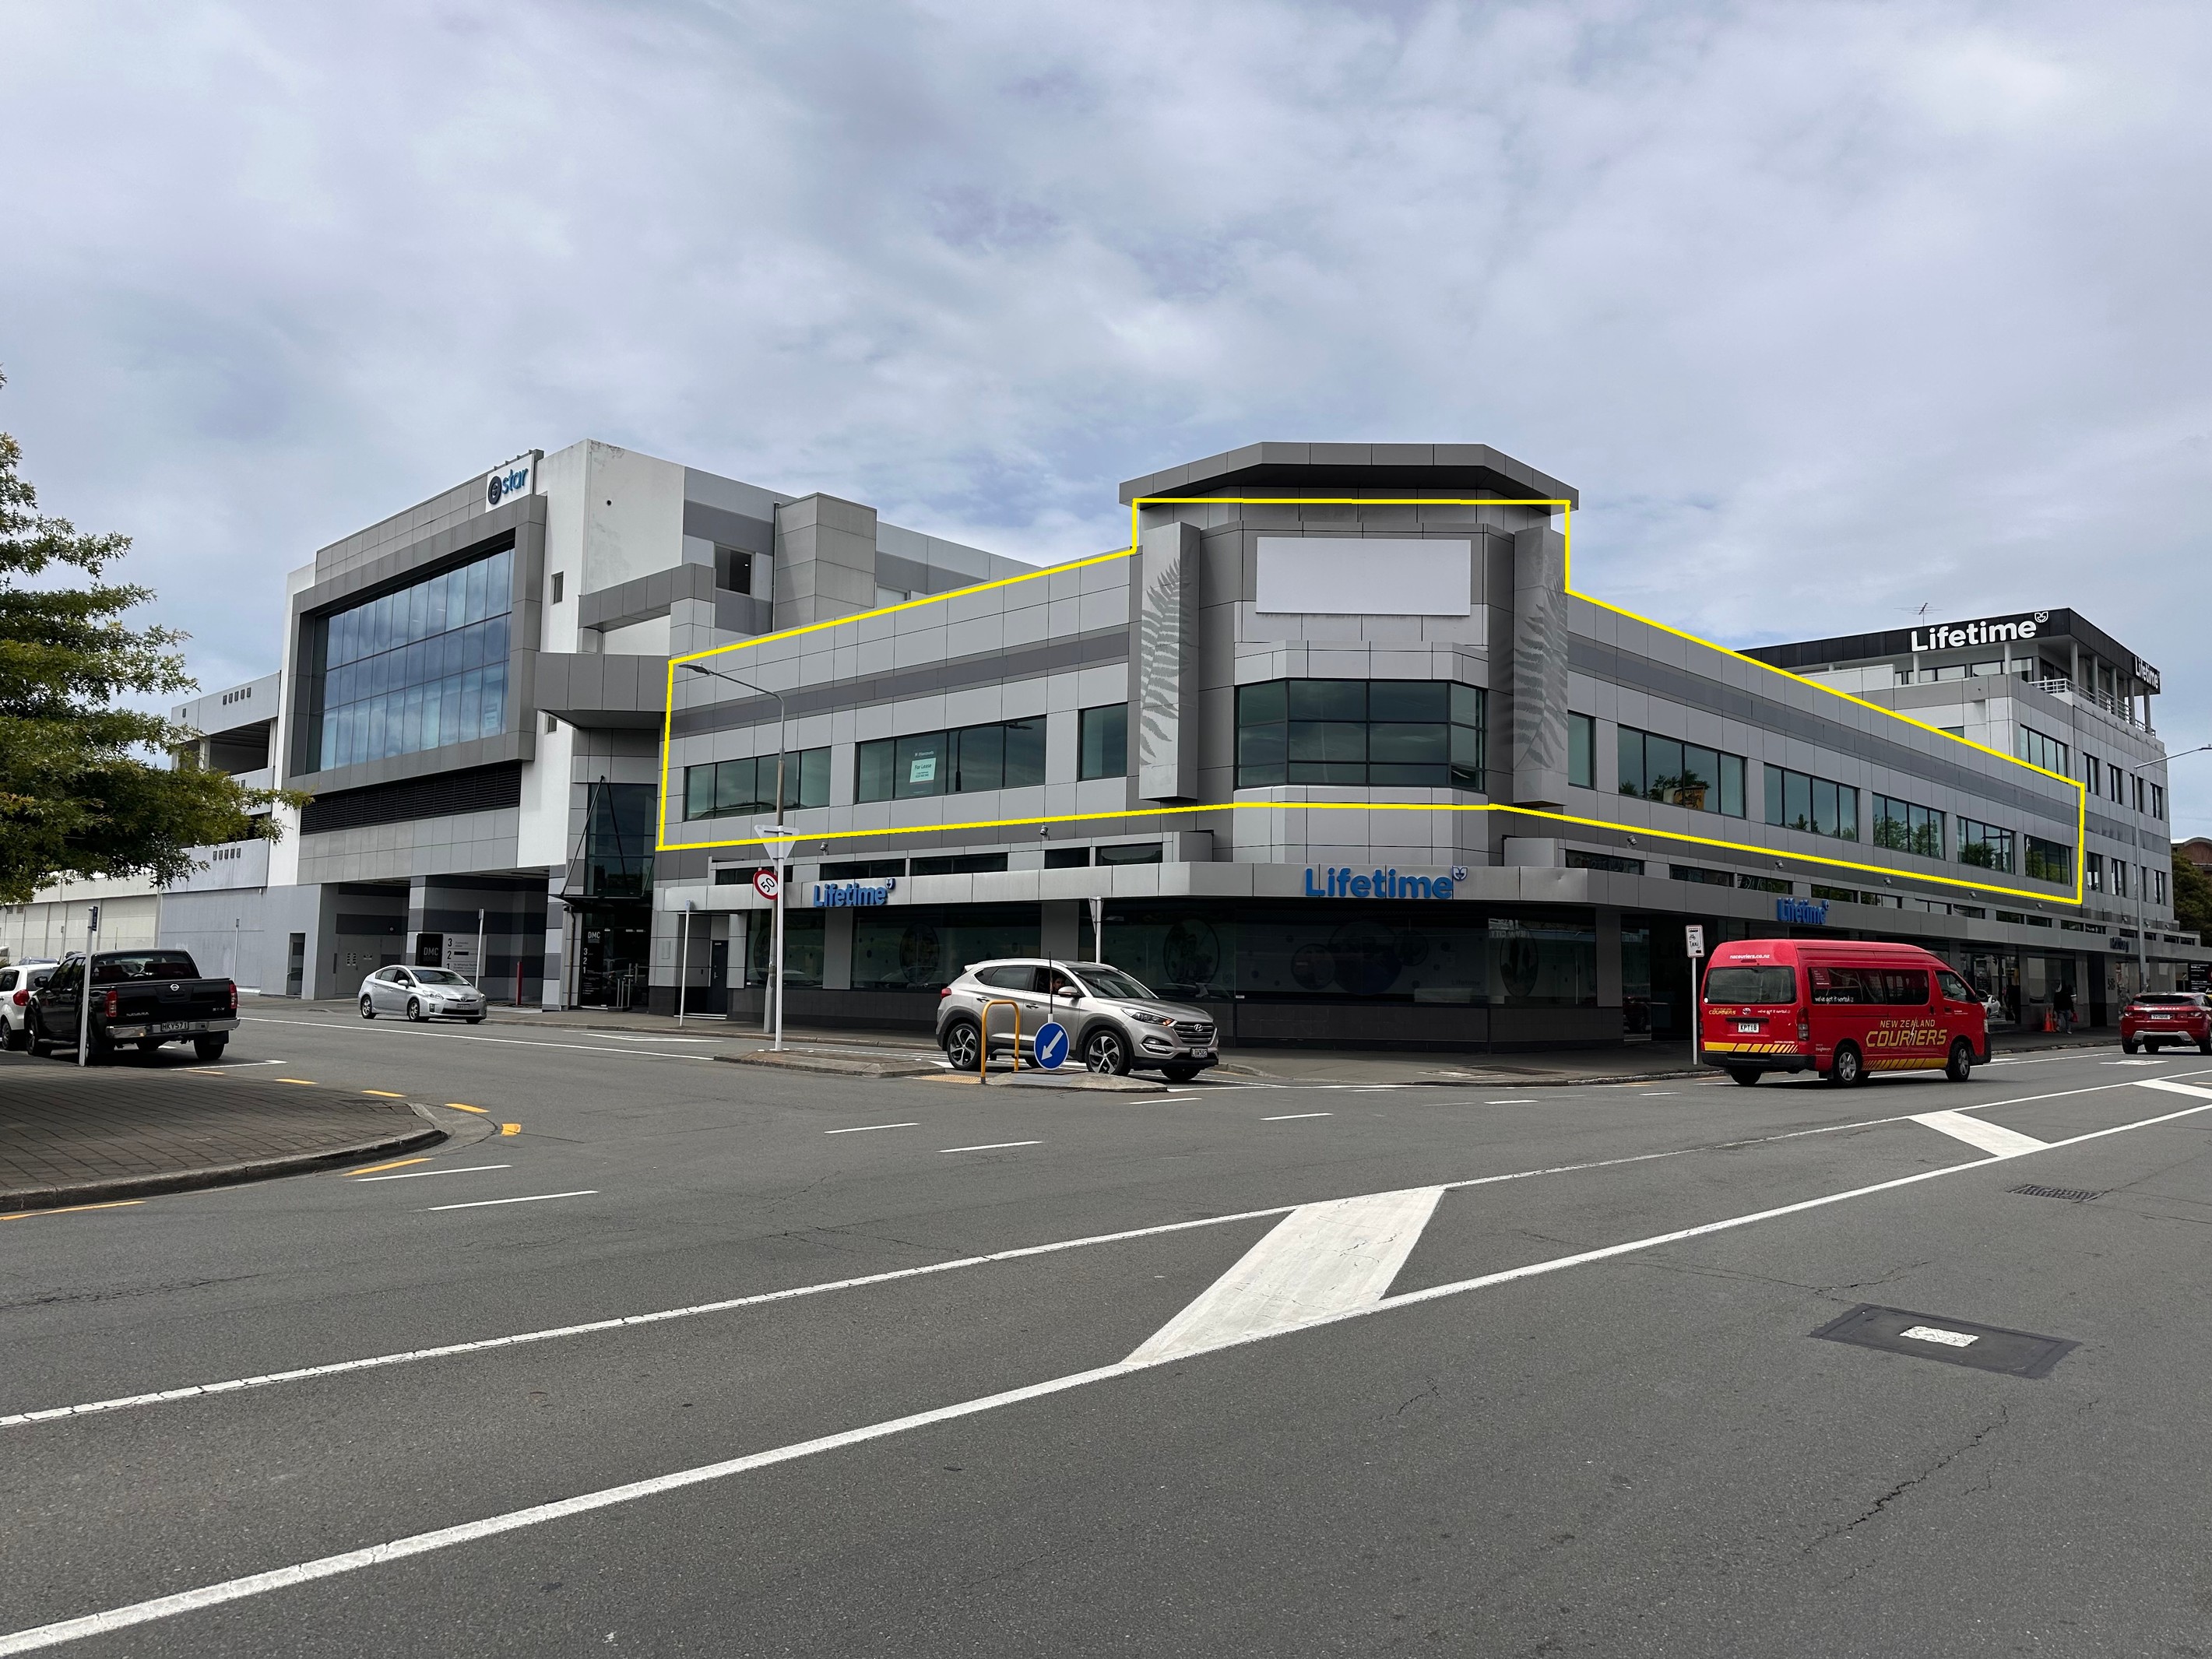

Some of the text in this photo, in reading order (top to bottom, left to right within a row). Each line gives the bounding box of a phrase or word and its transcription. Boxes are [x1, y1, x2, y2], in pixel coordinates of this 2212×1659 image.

[1911, 620, 2037, 652] Lifetime
[2134, 656, 2158, 689] Lifetime
[760, 877, 775, 893] 50
[1305, 867, 1453, 899] Lifetime
[813, 883, 888, 907] Lifetime
[1777, 898, 1826, 924] Lifetime
[424, 947, 439, 956] DMC
[448, 937, 452, 947] 3
[447, 951, 452, 959] 2
[1880, 1019, 1936, 1028] NEW ZEALAND
[1866, 1029, 1947, 1048] COURIERS
